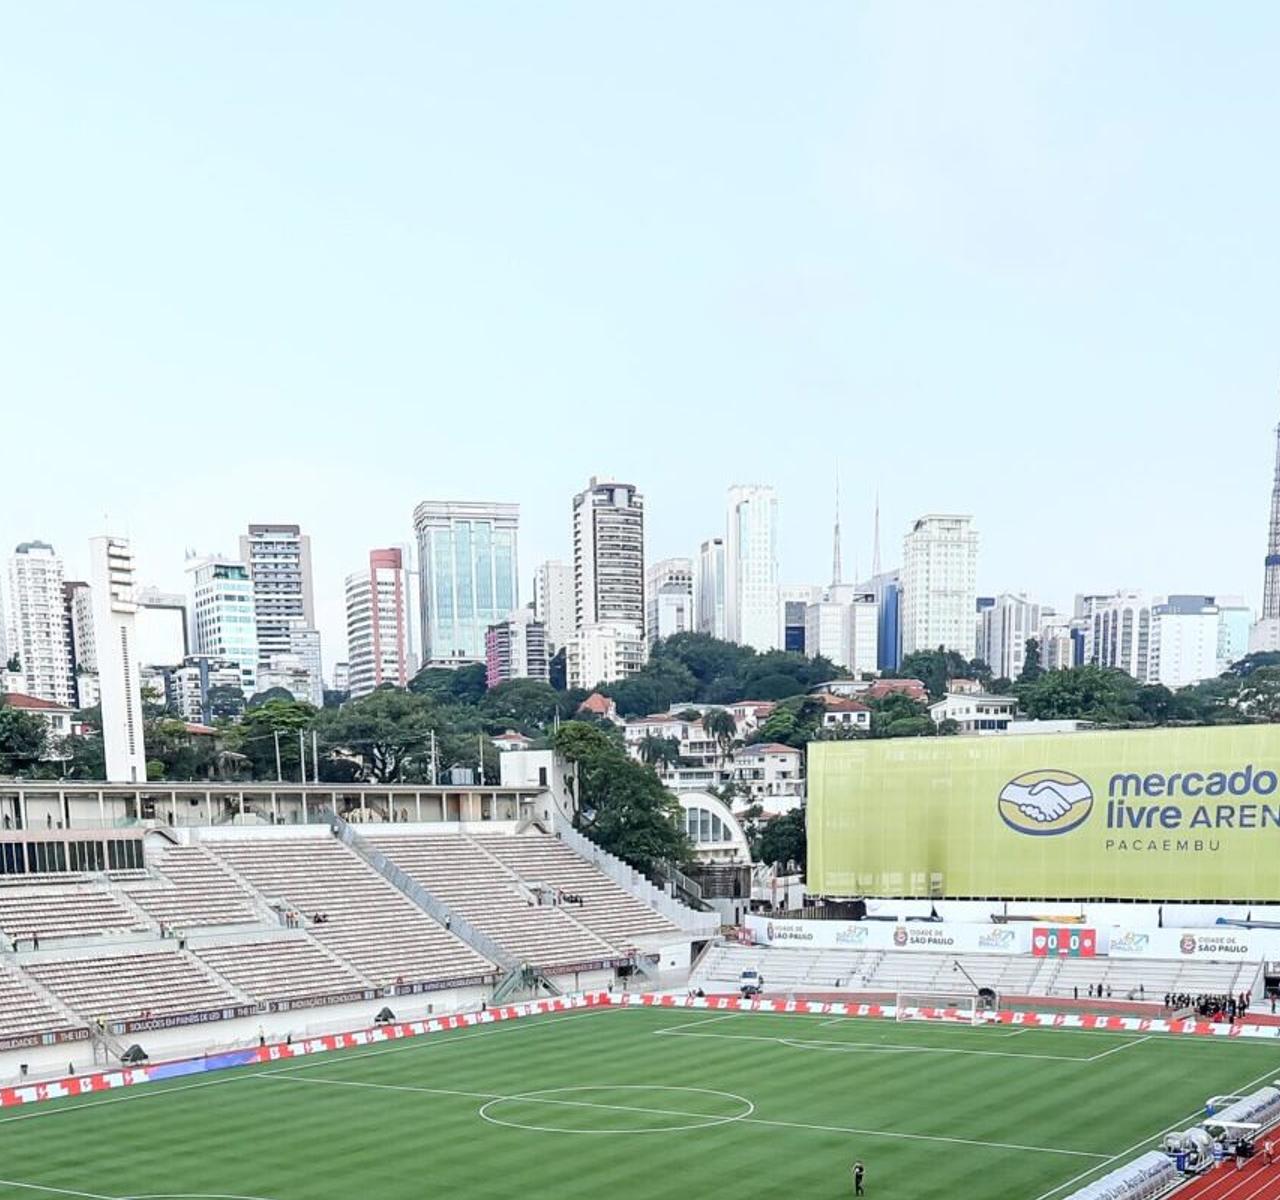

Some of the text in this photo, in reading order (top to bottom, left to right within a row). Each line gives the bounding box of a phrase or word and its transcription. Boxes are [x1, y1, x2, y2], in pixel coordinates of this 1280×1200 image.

[1108, 764, 1277, 797] mercado
[1107, 800, 1182, 829] livre
[1106, 839, 1220, 851] PACAEMBU
[1048, 935, 1057, 949] 0
[1070, 935, 1079, 949] 0
[1218, 945, 1248, 953] PAULO
